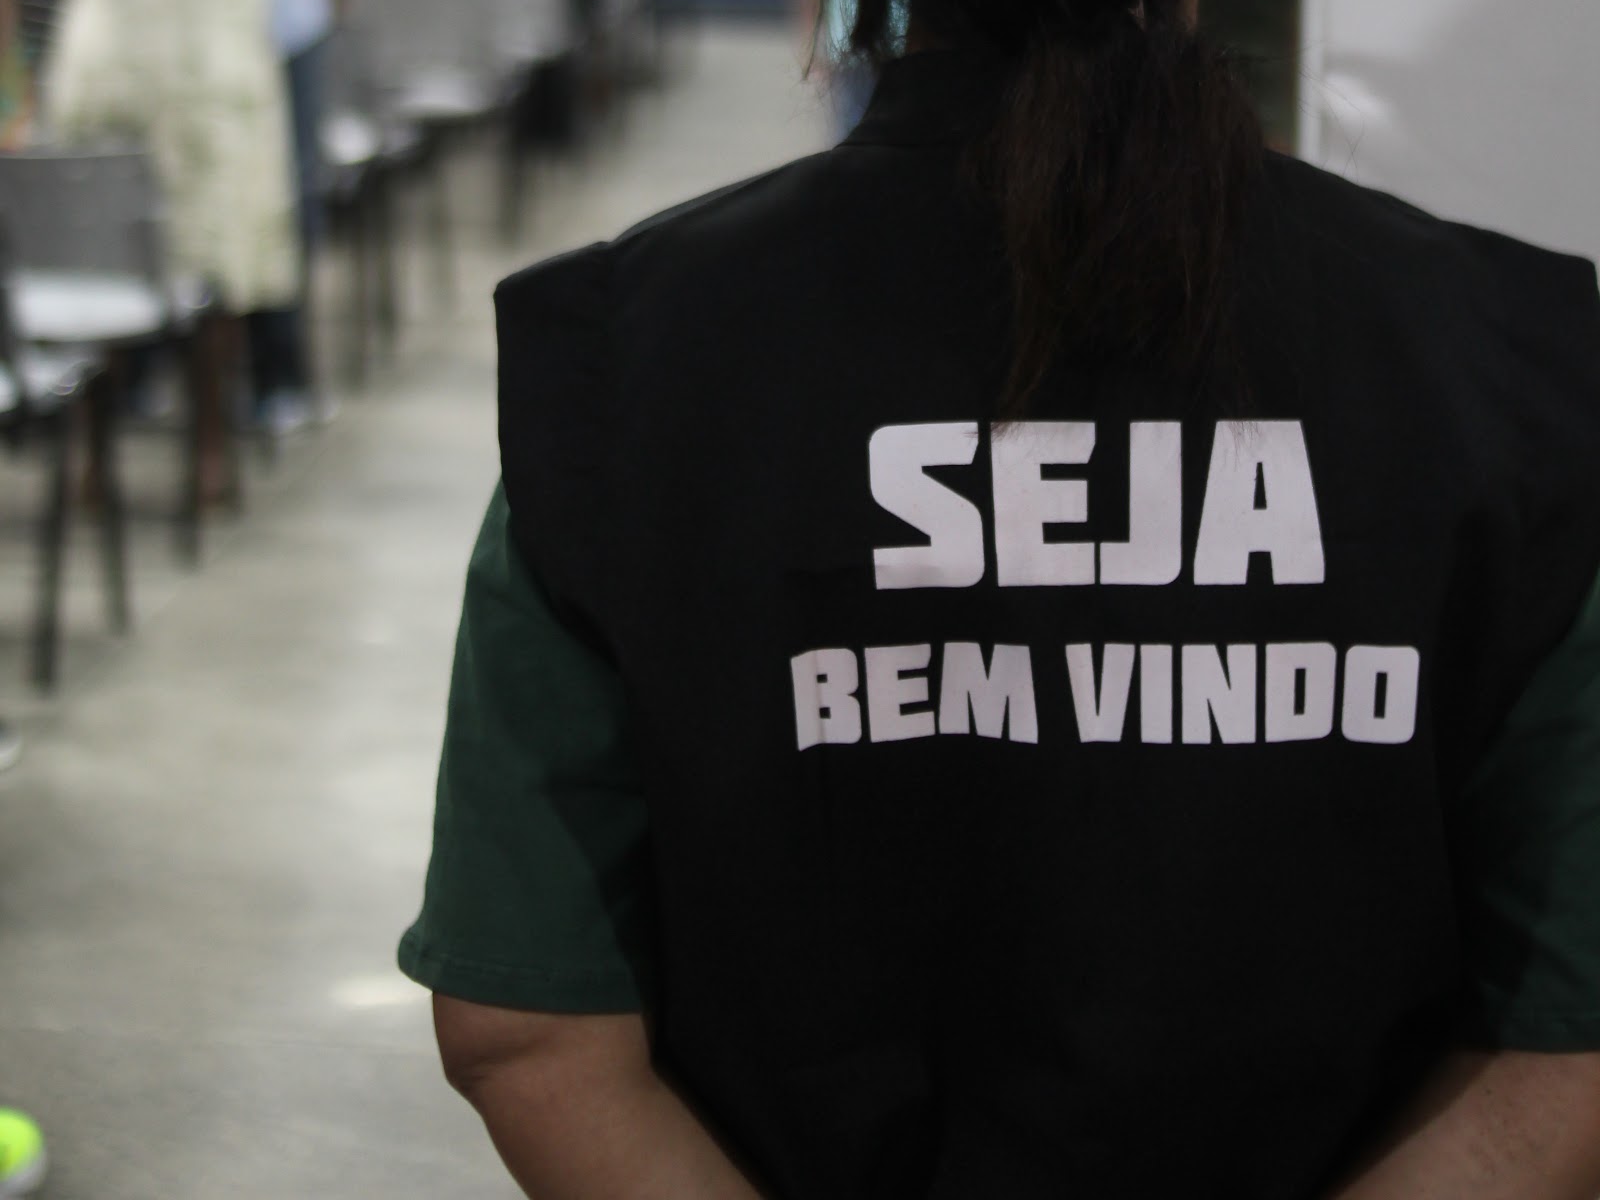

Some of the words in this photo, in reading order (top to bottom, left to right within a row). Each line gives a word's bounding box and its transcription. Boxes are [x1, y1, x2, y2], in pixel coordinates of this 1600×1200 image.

[868, 419, 1325, 589] SEJA
[790, 641, 1039, 750] BEM
[1065, 641, 1420, 744] VINDO
